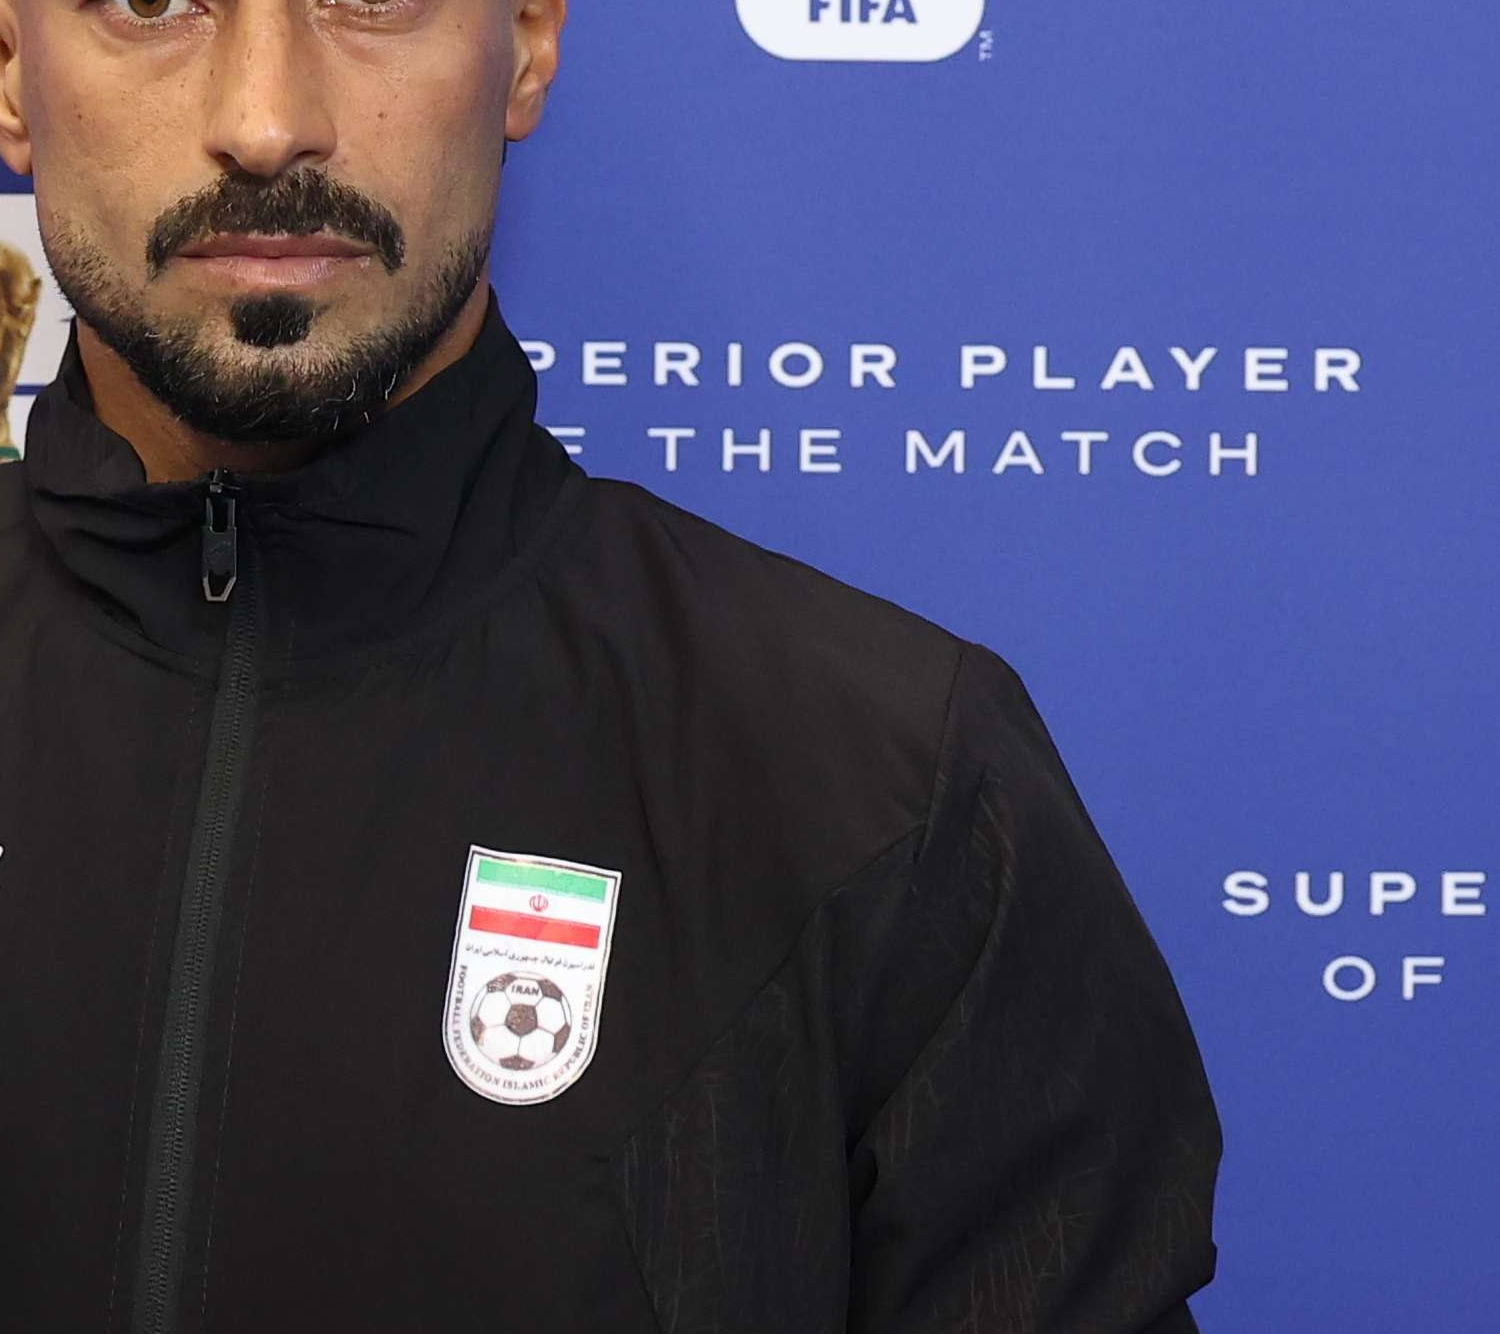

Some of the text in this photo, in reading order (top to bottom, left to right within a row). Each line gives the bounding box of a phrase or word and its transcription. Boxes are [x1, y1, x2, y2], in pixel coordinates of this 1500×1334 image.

[518, 340, 1361, 392] PERIOR PLAYER
[647, 427, 1257, 476] THE MATCH
[511, 985, 540, 997] IRAN
[1322, 955, 1445, 1001] OF
